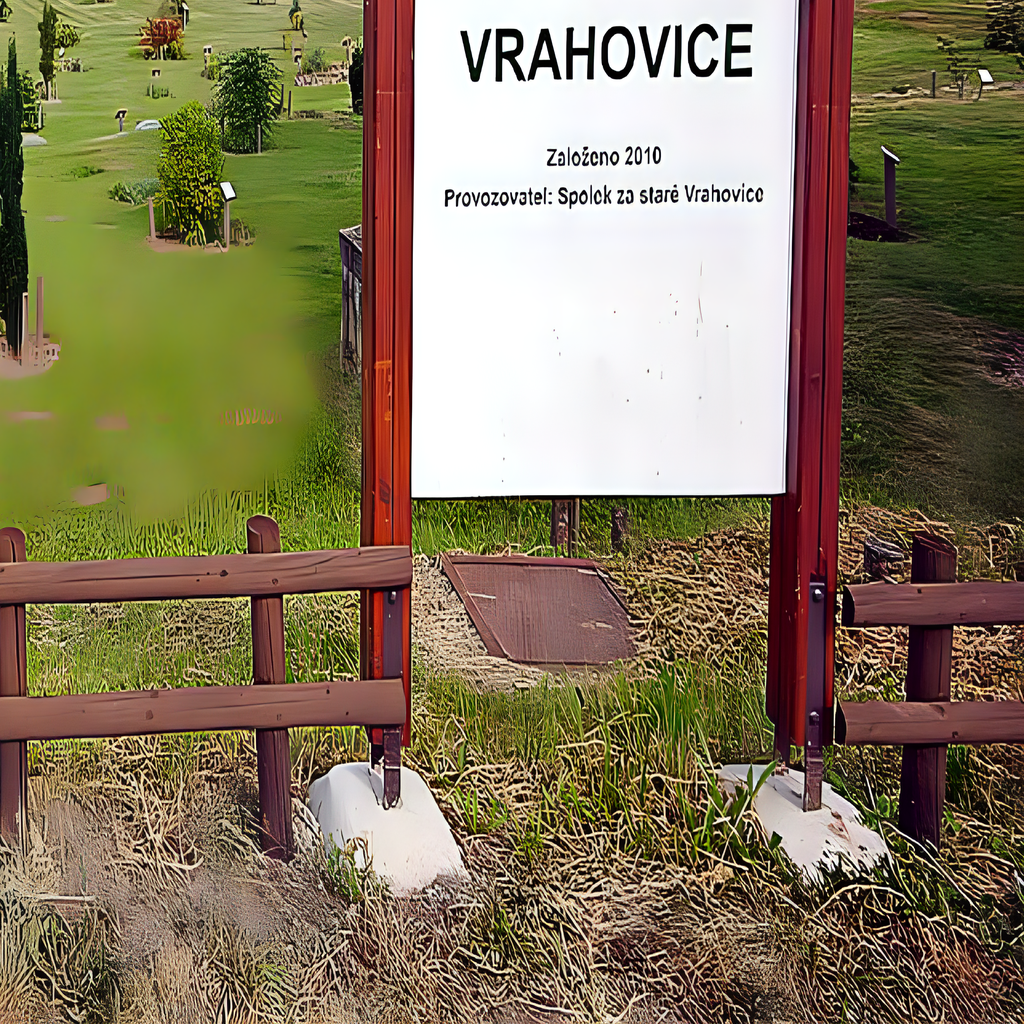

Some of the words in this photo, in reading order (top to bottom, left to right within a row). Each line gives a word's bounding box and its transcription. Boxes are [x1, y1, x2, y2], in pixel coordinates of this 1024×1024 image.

[459, 23, 753, 83] VRAHOVICE
[624, 145, 662, 166] 2010
[444, 186, 553, 208] Provozovatel:
[616, 189, 635, 205] za
[639, 183, 679, 205] staré
